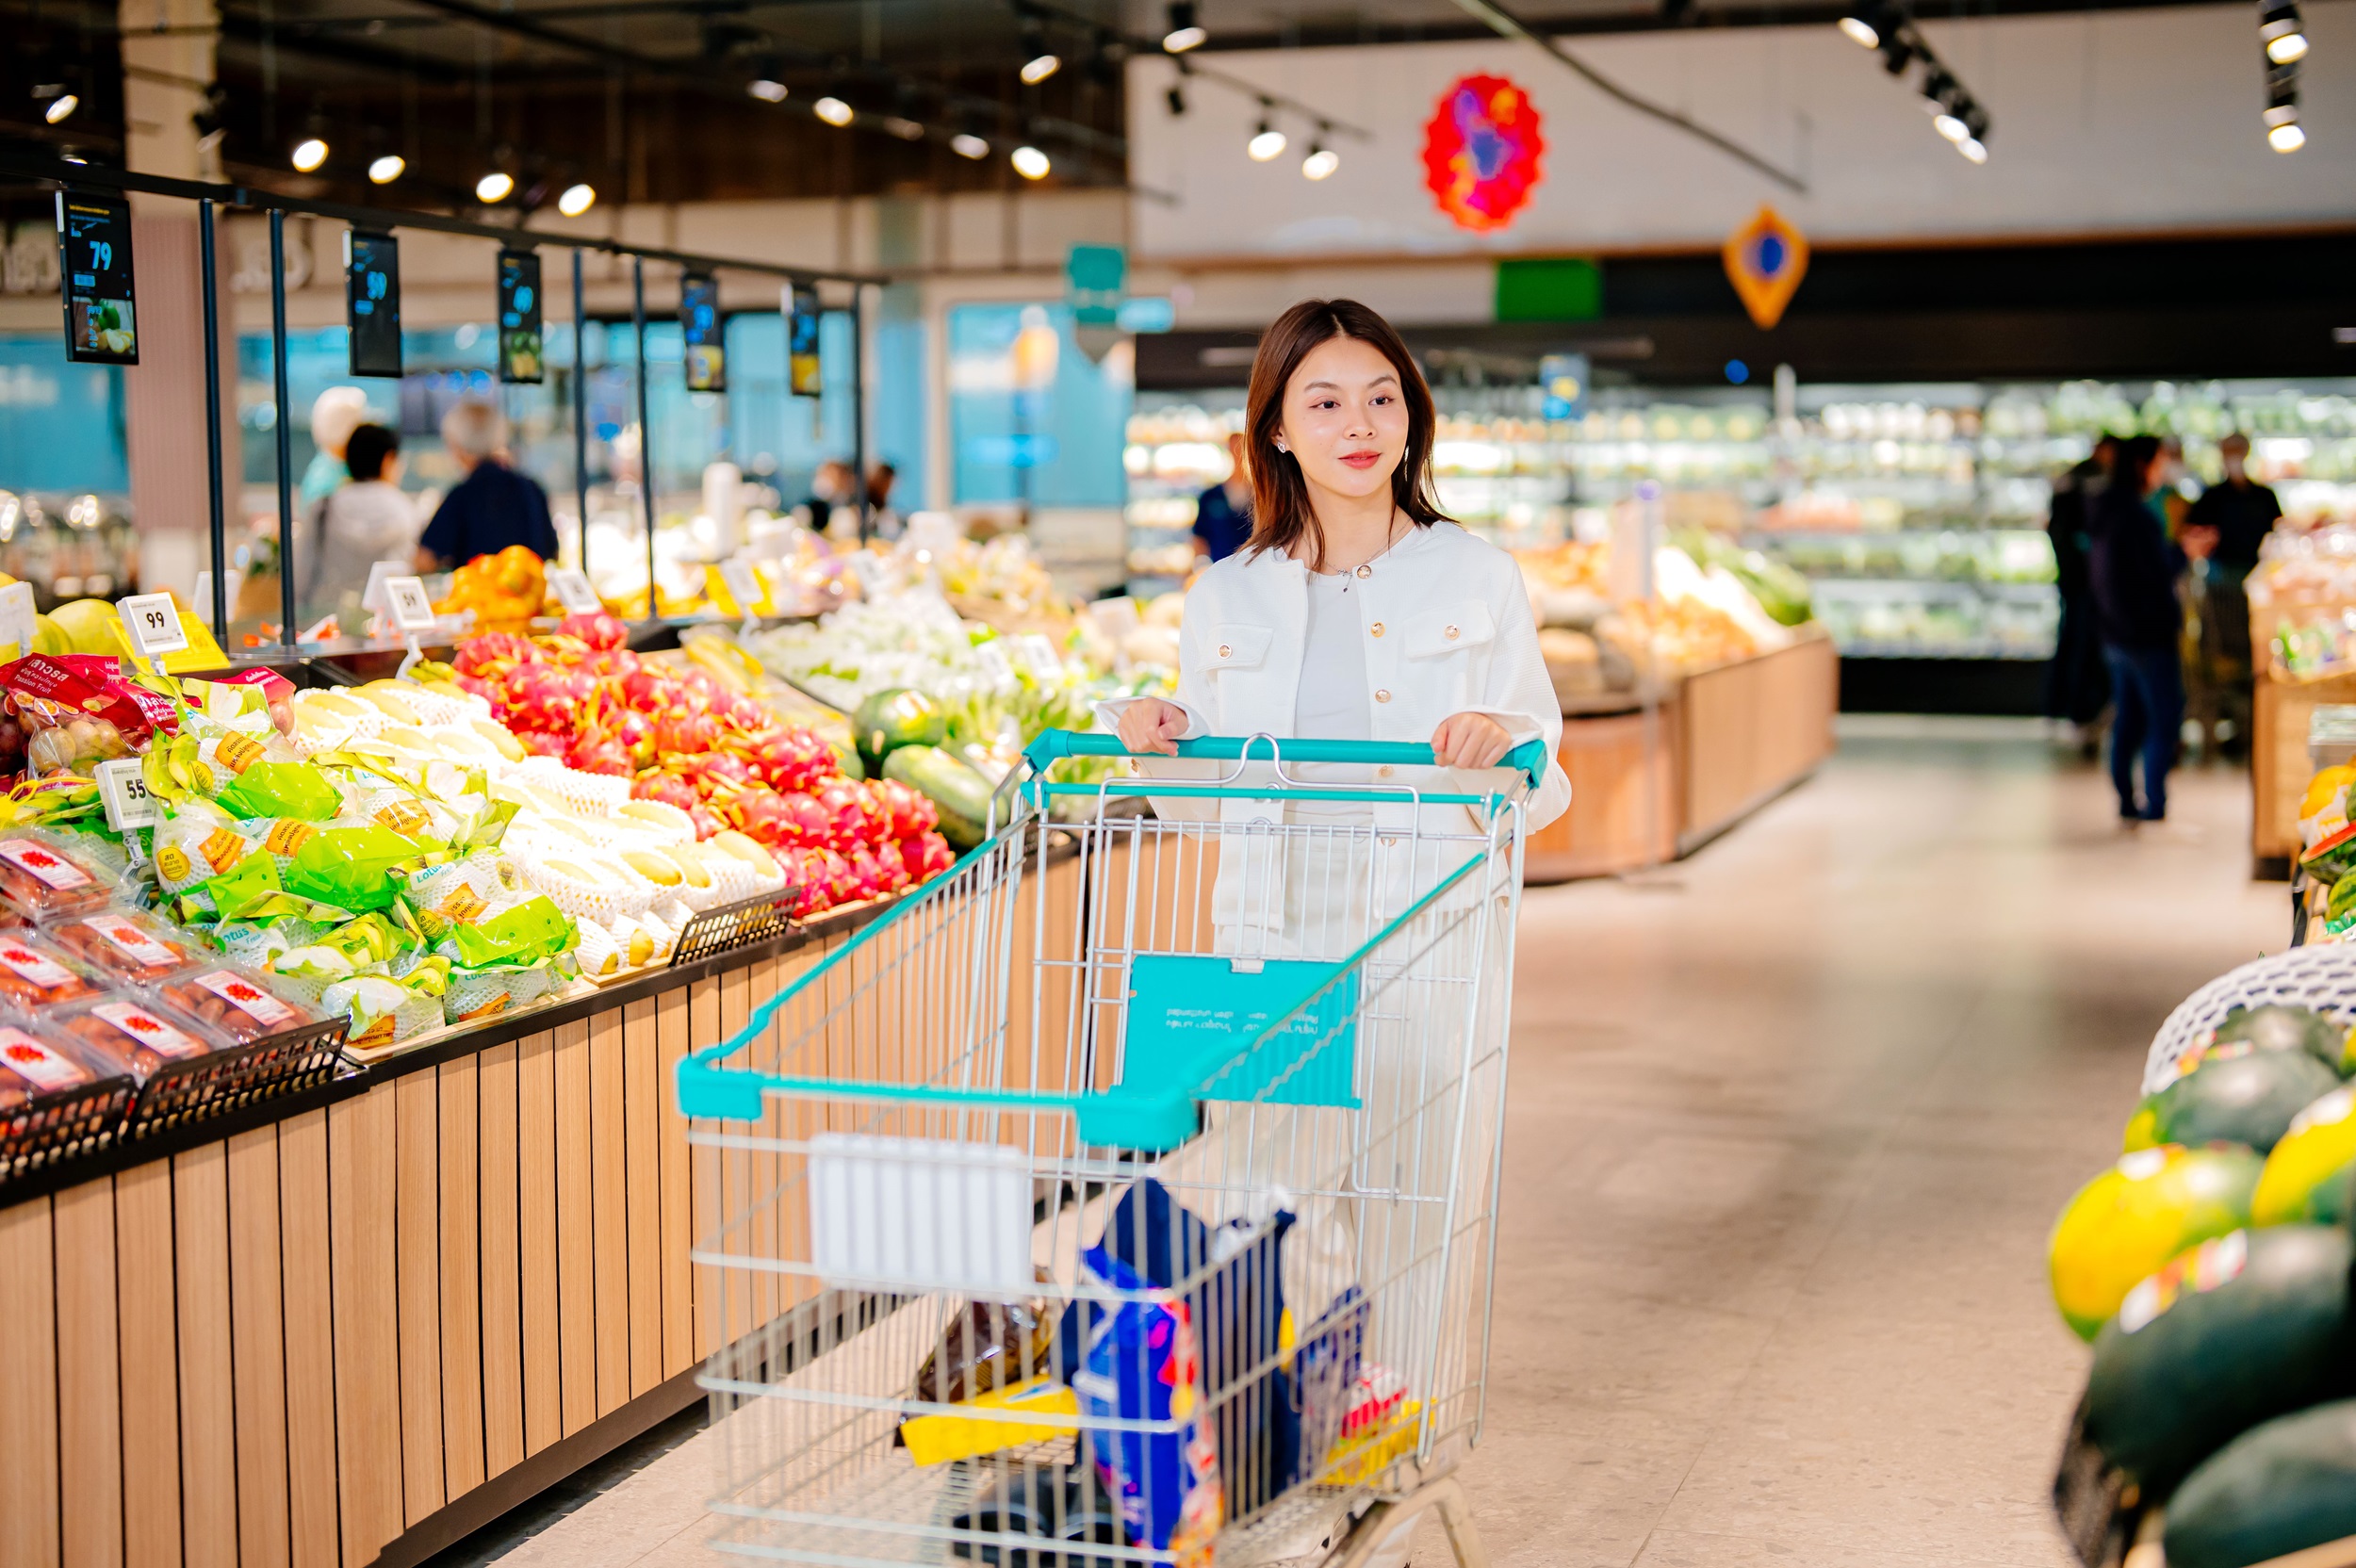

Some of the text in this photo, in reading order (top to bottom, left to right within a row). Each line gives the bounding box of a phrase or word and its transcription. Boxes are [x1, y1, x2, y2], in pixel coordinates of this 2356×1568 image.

[89, 240, 112, 270] 79
[146, 612, 165, 629] 99
[14, 674, 52, 694] Passion Fruit
[126, 778, 147, 800] 55
[222, 927, 250, 942] otus
